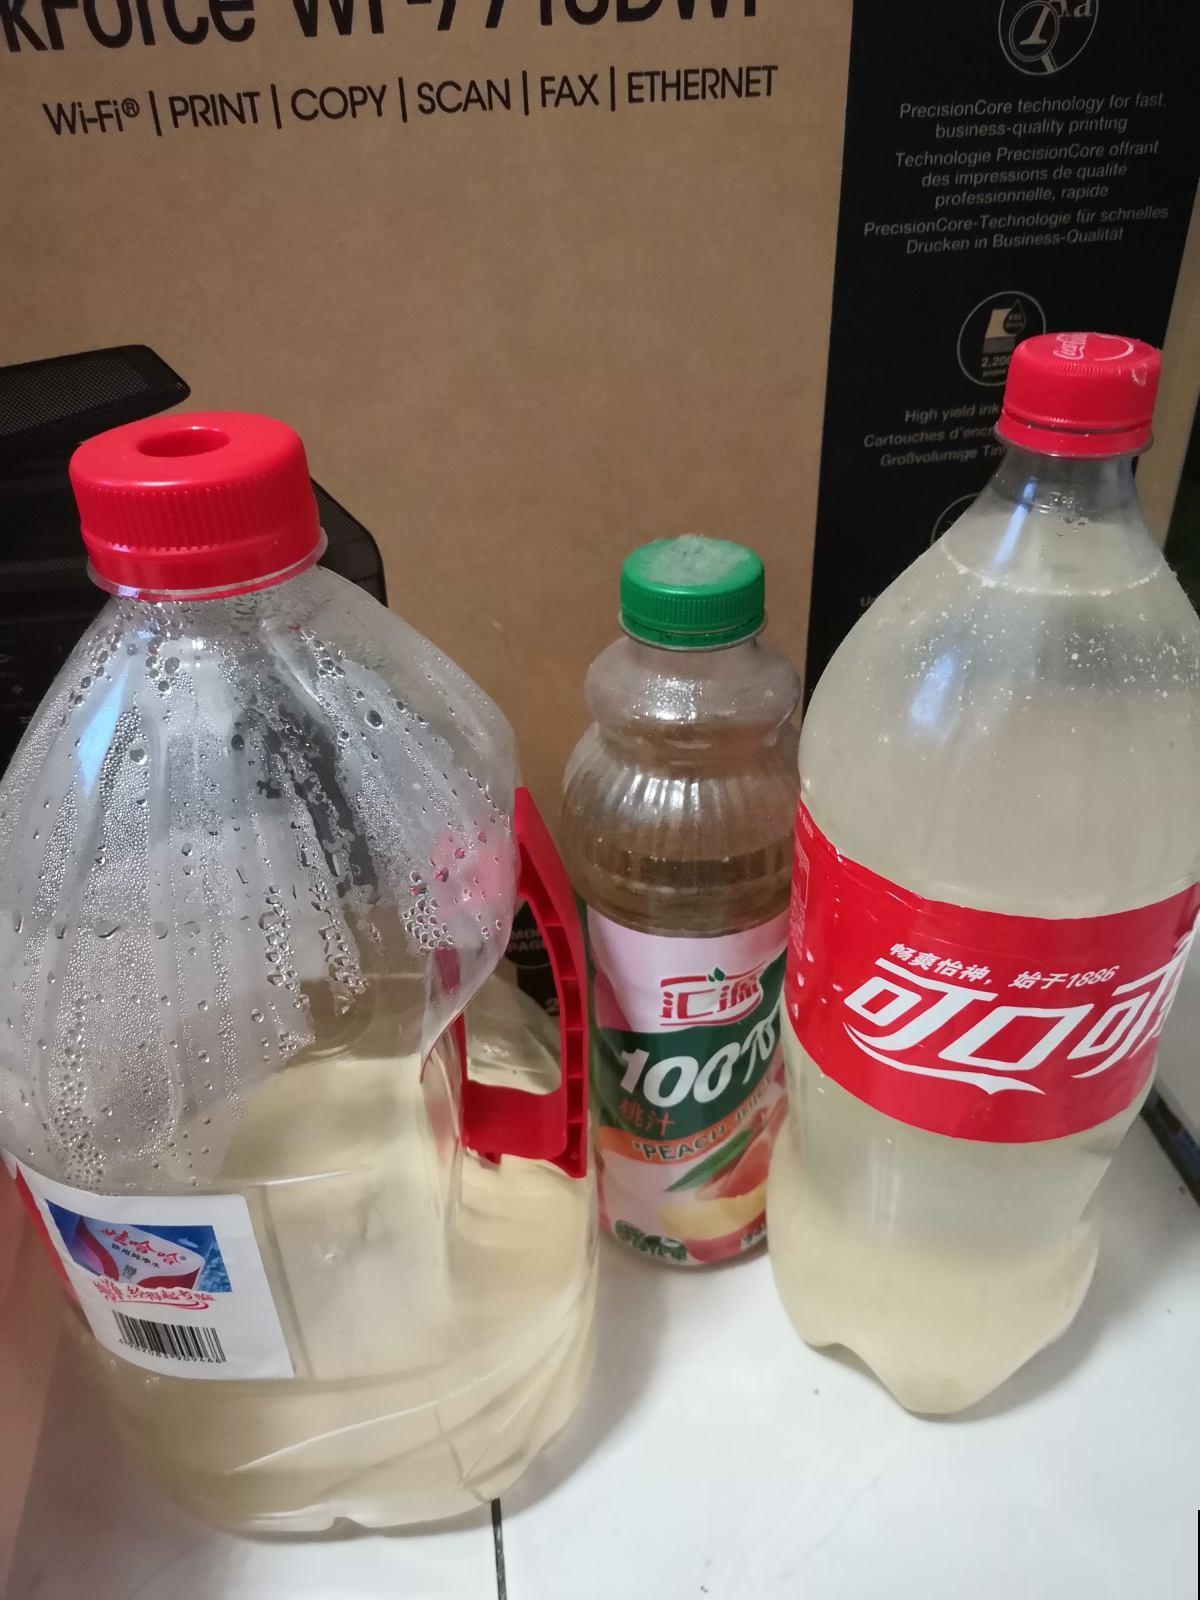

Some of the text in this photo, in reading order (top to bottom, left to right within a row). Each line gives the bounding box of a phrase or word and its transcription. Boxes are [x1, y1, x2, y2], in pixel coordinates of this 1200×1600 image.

[168, 91, 261, 129] PRINT
[291, 84, 388, 121] COPY
[417, 78, 511, 115] SCAN
[540, 73, 600, 108] FAX
[627, 65, 779, 104] ETHERNET
[899, 99, 1013, 119] PrecisionCore
[1017, 96, 1102, 114] technology
[1109, 94, 1130, 108] for
[935, 117, 1129, 139] business-quality printing
[895, 140, 1160, 168] Technologie PrecisionCore offrant
[921, 172, 950, 187] des
[954, 166, 1049, 187] impressions
[1052, 165, 1073, 180] de
[935, 184, 1110, 210] professionnelle, rapide
[863, 212, 1072, 237] PrecisionCore-Technologie
[1100, 205, 1169, 222] schnelles
[906, 237, 970, 254] Drucken
[974, 235, 988, 249] in
[904, 407, 938, 425] High
[941, 403, 976, 423] yield
[863, 425, 995, 449] Cartouches d'encr
[880, 448, 979, 468] Großvolumige
[618, 1016, 776, 1108] 100%
[618, 1098, 676, 1138] 桃汁
